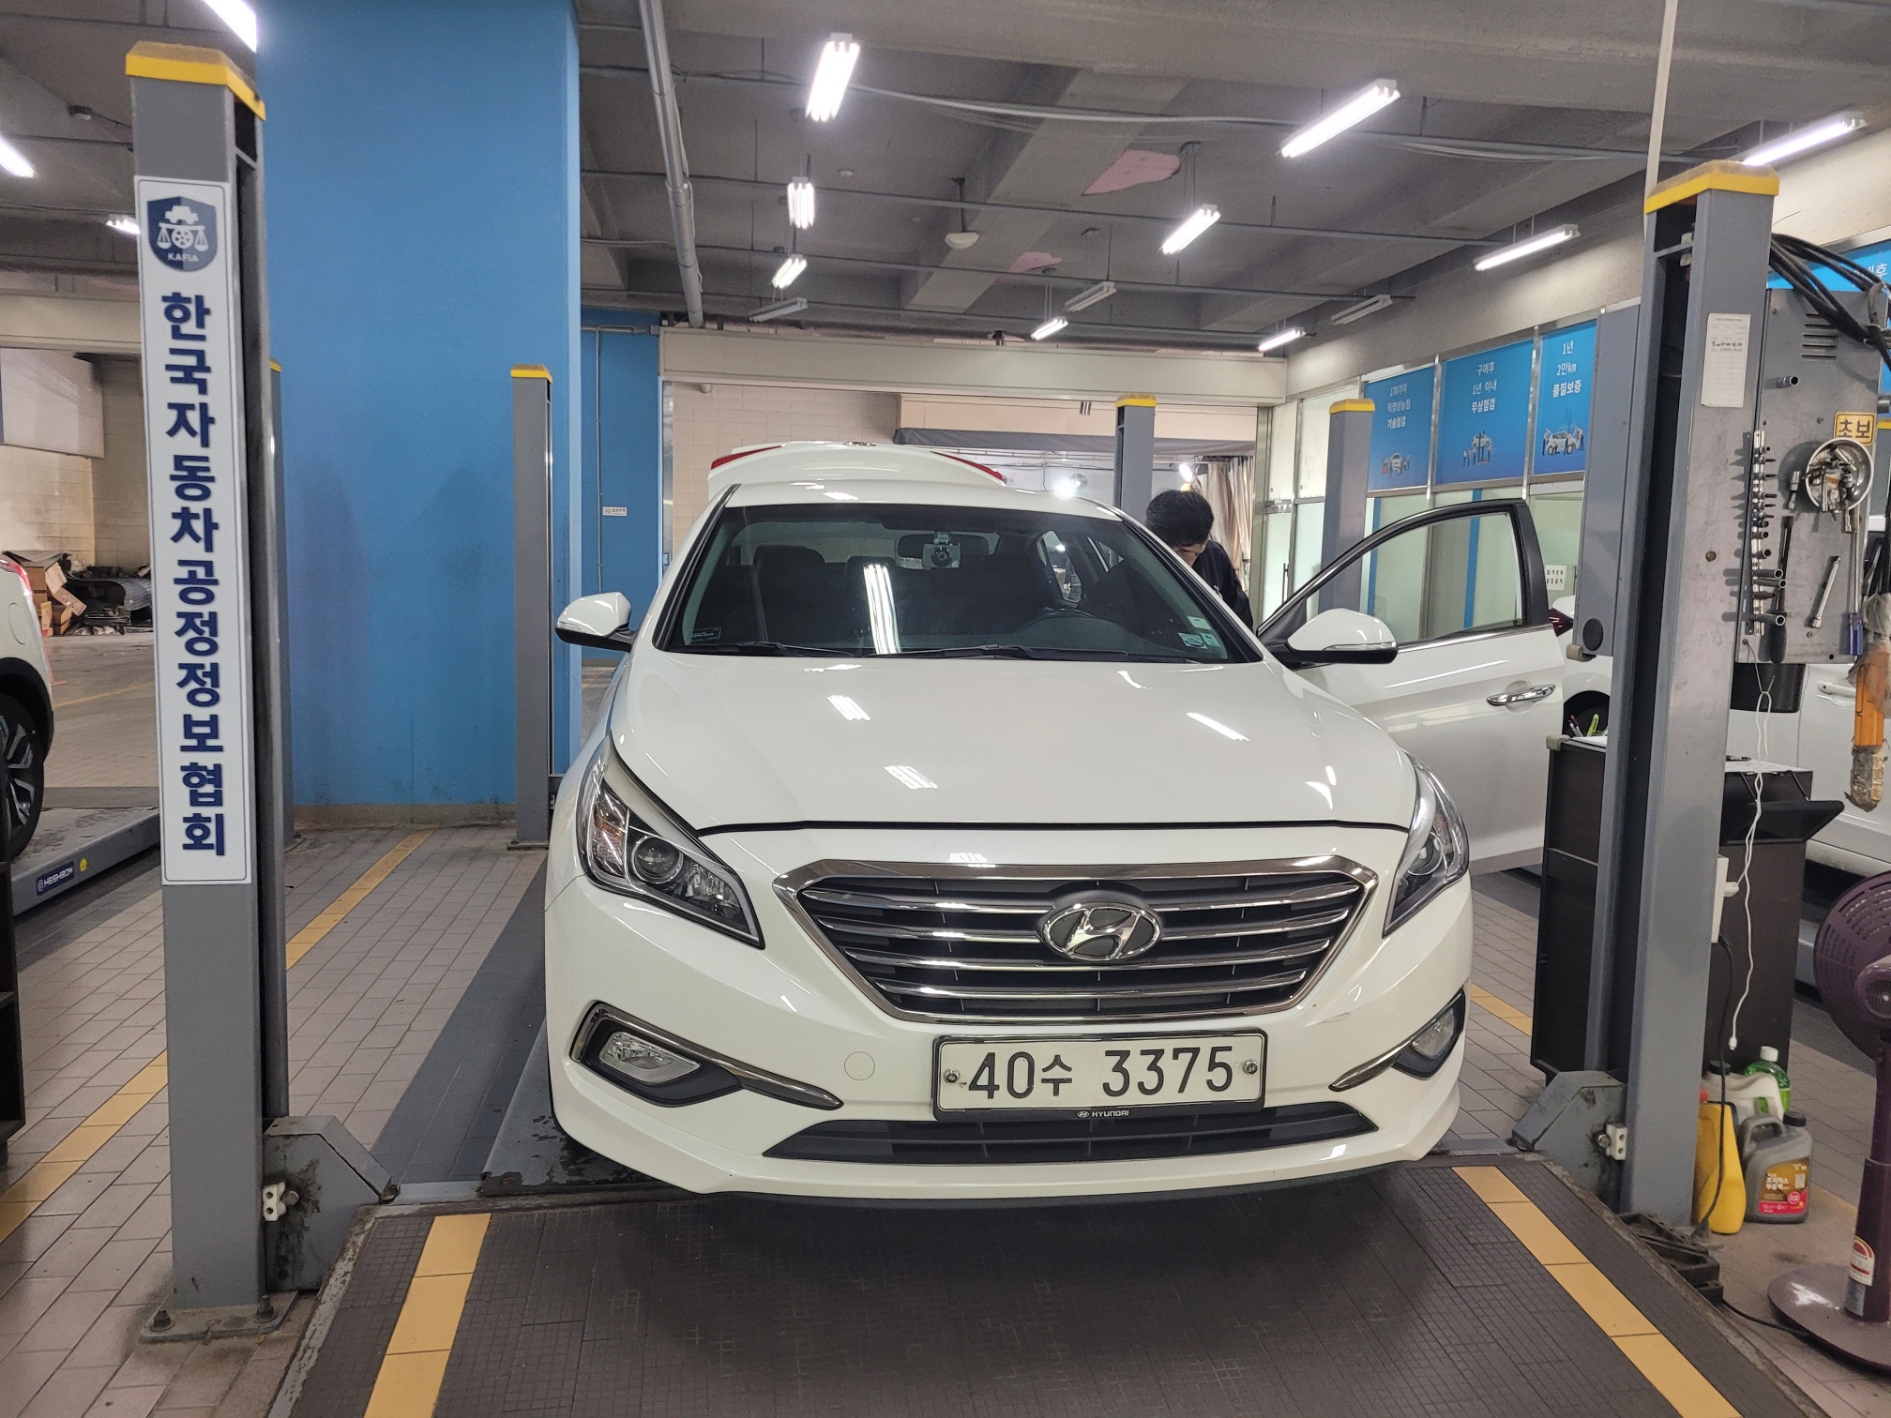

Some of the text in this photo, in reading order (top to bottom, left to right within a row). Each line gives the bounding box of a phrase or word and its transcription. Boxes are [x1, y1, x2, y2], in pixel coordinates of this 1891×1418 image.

[1562, 339, 1574, 354] 1년
[1477, 361, 1495, 376] 구매후
[1556, 362, 1577, 376] 2만km
[1472, 378, 1497, 395] 1년 이내
[1552, 379, 1582, 398] 품질보증
[1472, 397, 1496, 414] 무상점검
[1837, 419, 1871, 439] 초보
[161, 291, 225, 856] 한국자동차공정정보협회
[968, 1045, 1233, 1099] 40수 3375
[1091, 1109, 1130, 1118] HYUNDAI
